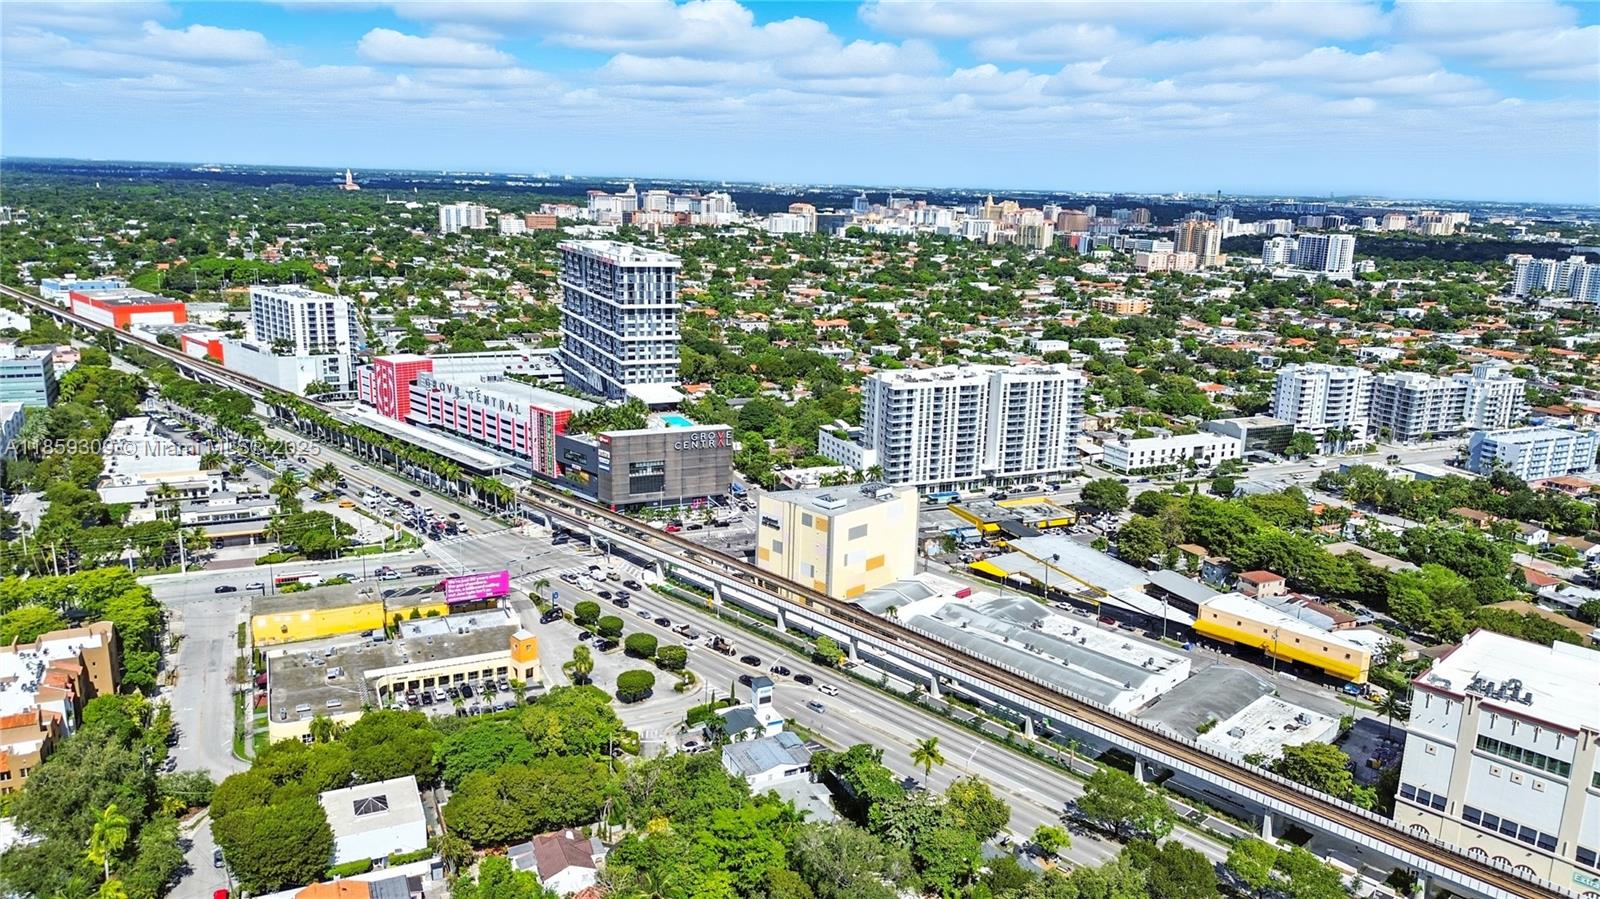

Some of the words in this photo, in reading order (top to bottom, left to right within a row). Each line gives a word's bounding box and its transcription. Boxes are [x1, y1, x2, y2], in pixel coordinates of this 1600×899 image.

[466, 390, 521, 415] CENTRAL
[690, 430, 732, 441] GROVE
[674, 438, 732, 450] CENTRAL
